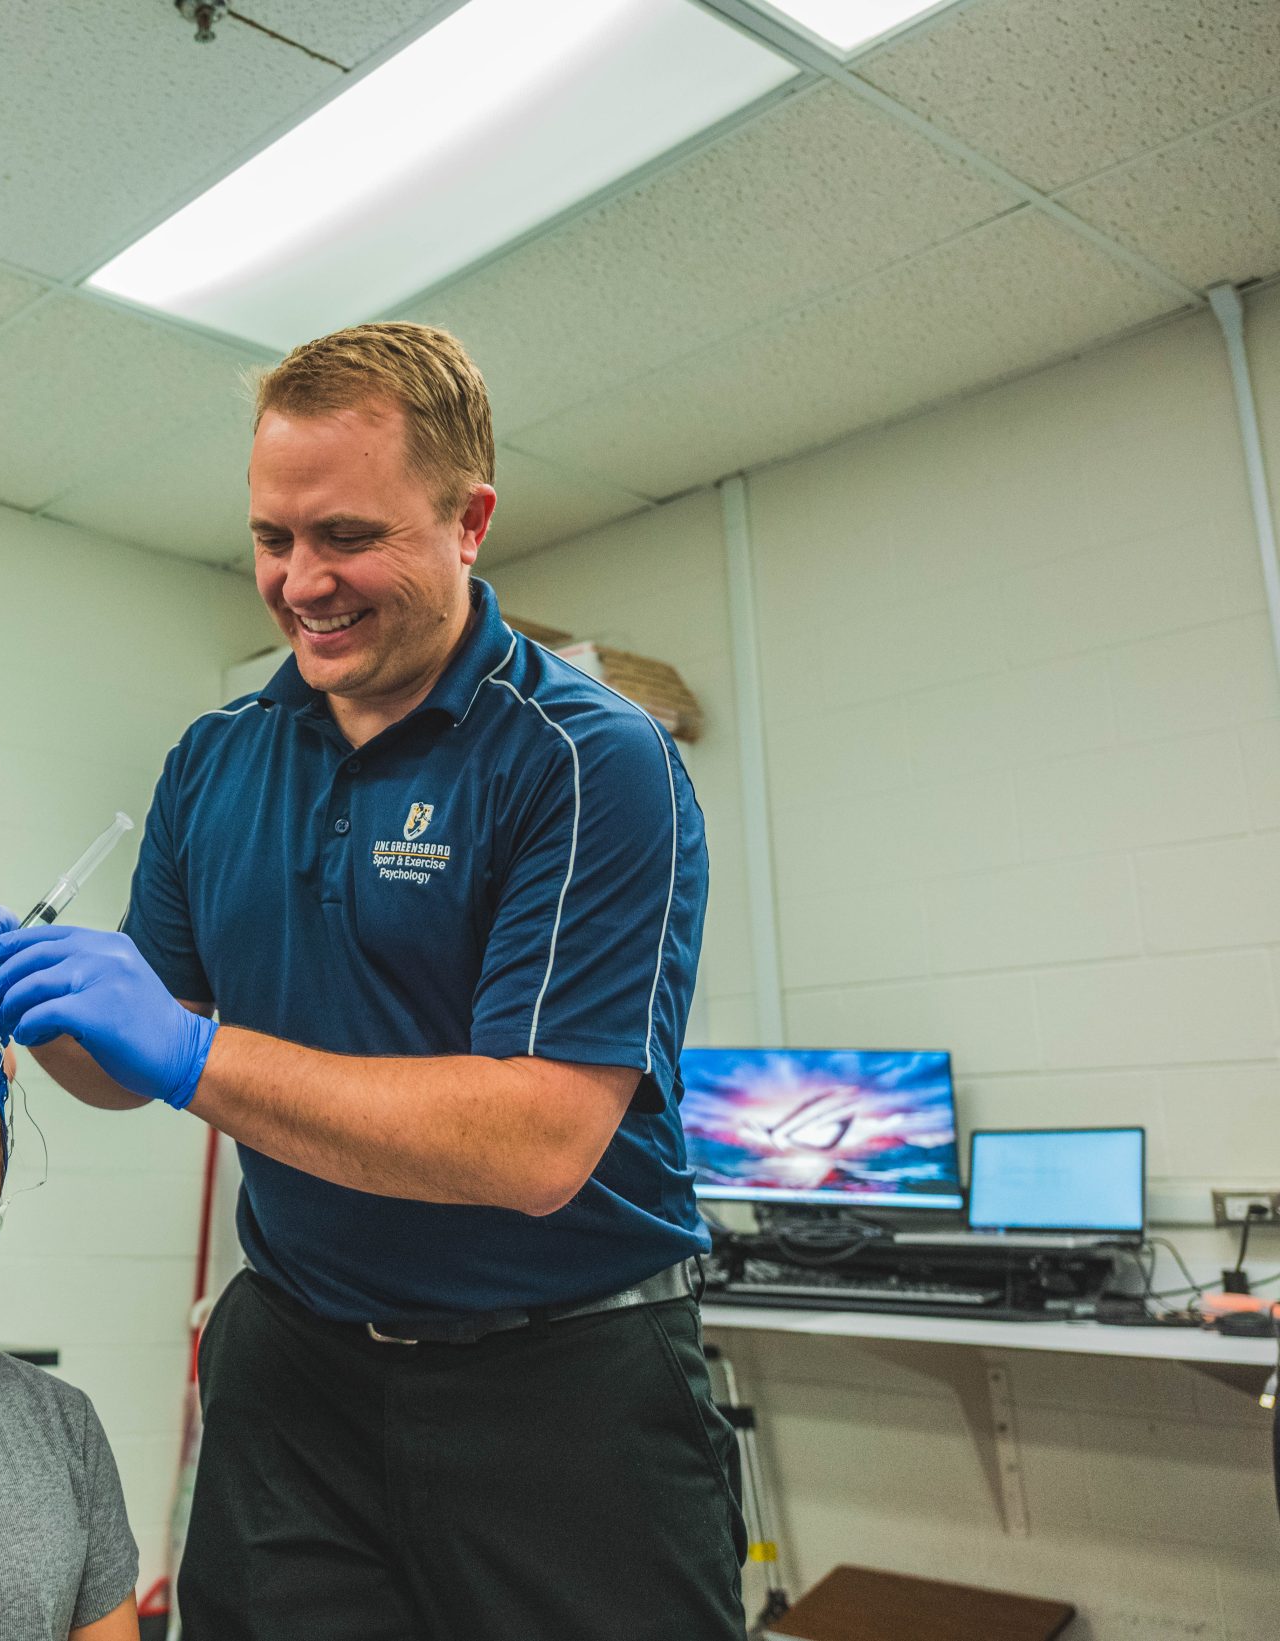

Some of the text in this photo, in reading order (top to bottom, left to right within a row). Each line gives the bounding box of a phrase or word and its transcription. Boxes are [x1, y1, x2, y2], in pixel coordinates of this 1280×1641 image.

[374, 840, 451, 857] UNC GREENSBORO
[373, 854, 446, 870] Sport & Exercise
[379, 869, 431, 884] Psychology
